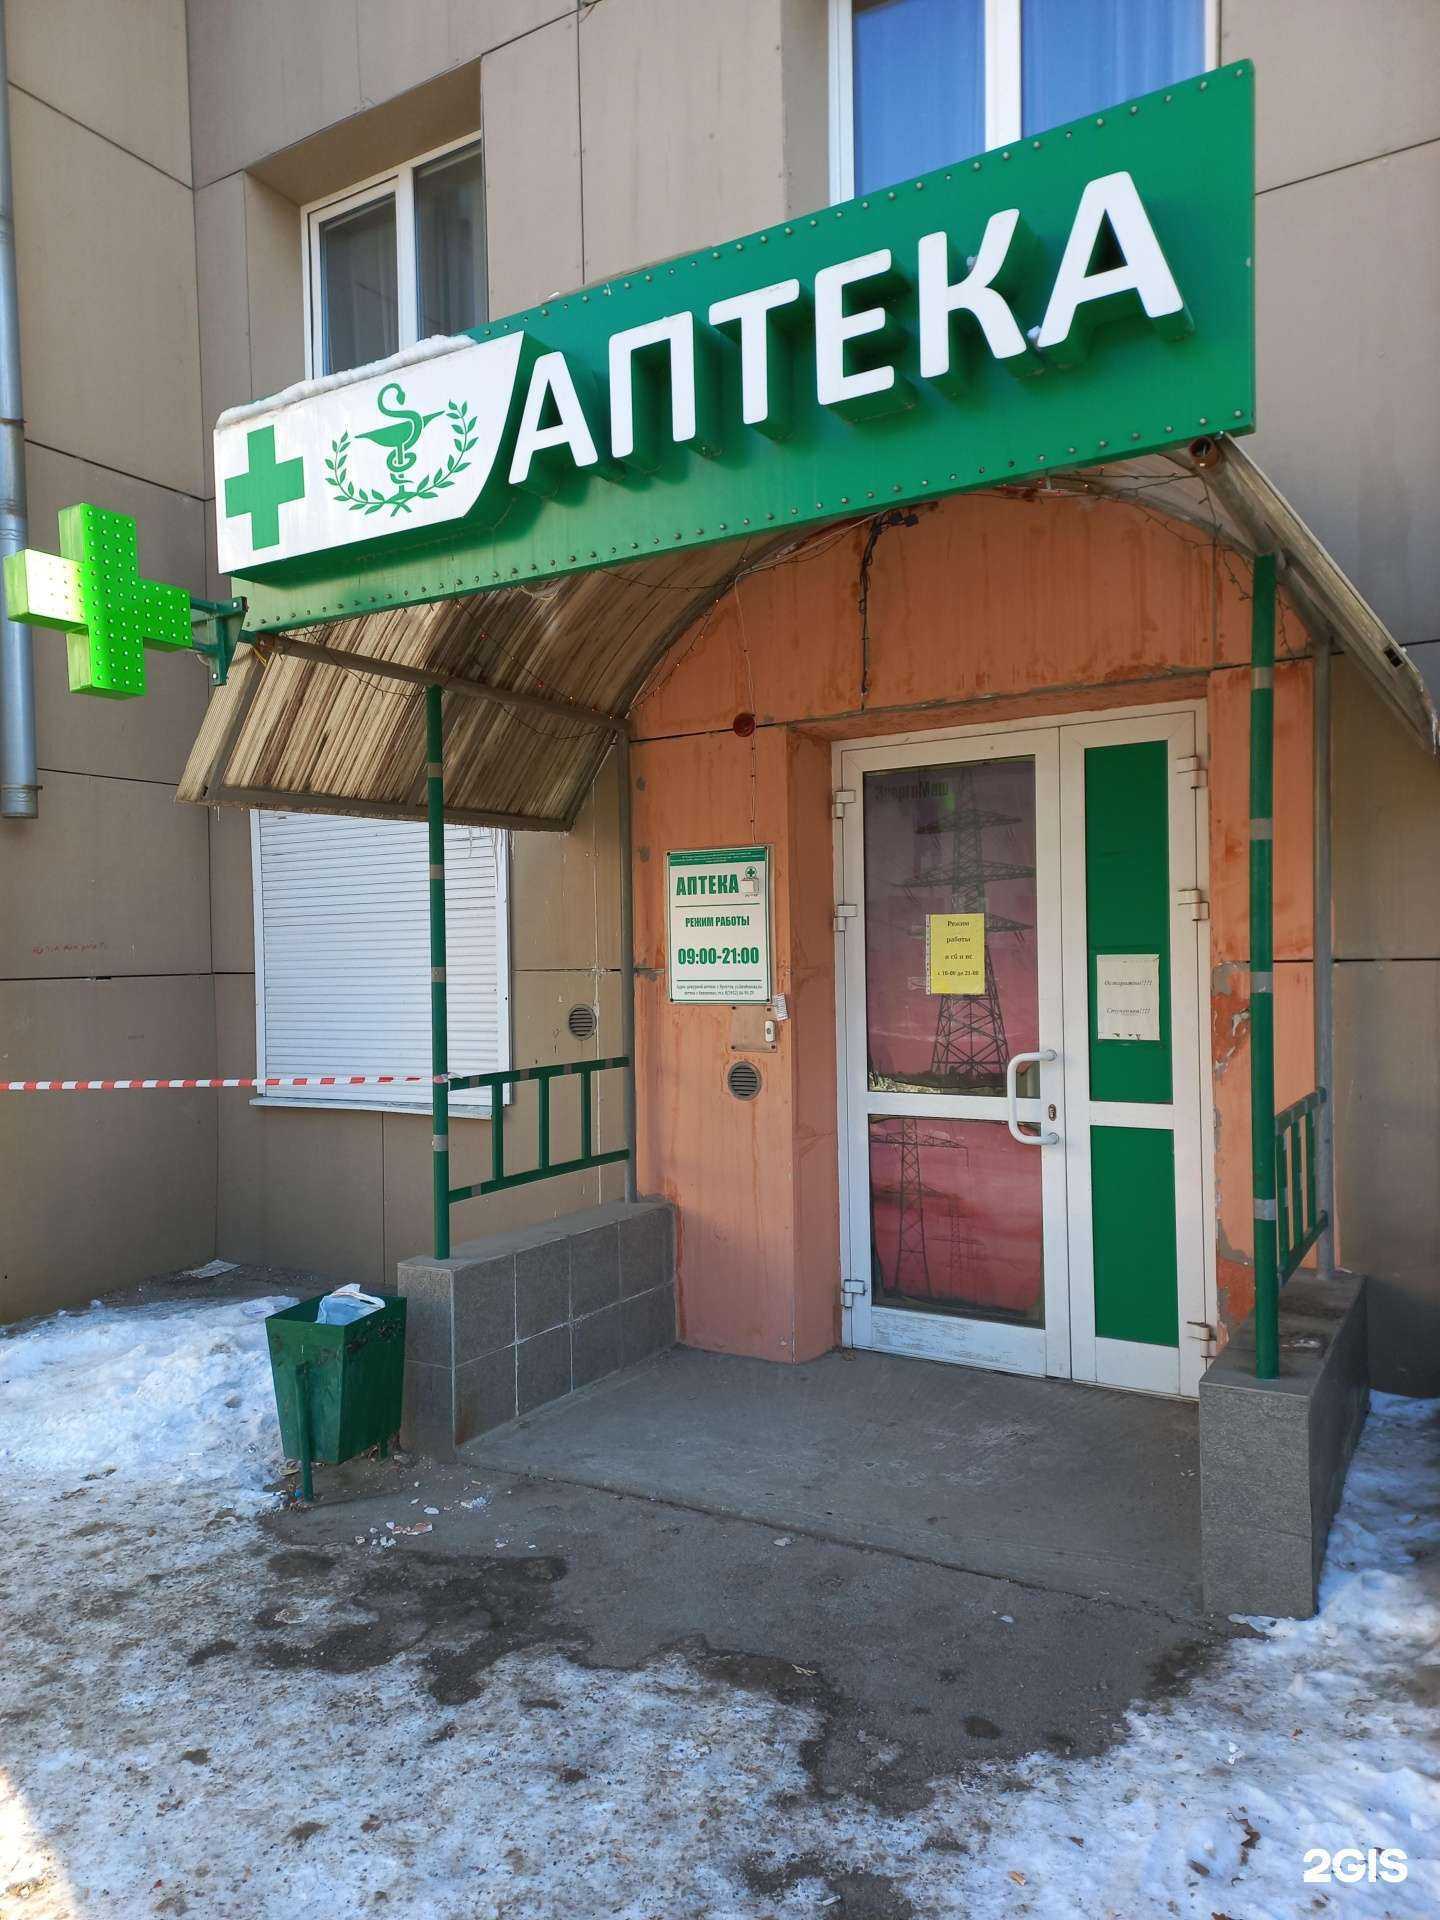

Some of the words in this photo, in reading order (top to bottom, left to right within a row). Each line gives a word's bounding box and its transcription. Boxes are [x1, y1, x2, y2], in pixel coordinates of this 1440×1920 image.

[508, 170, 1184, 485] АПТЕКА
[676, 874, 739, 895] АПТЕКА
[685, 917, 714, 927] РЕЖИМ
[715, 916, 749, 926] РАБОТЫ
[946, 936, 971, 944] работы
[678, 947, 759, 965] 09:00-21:00
